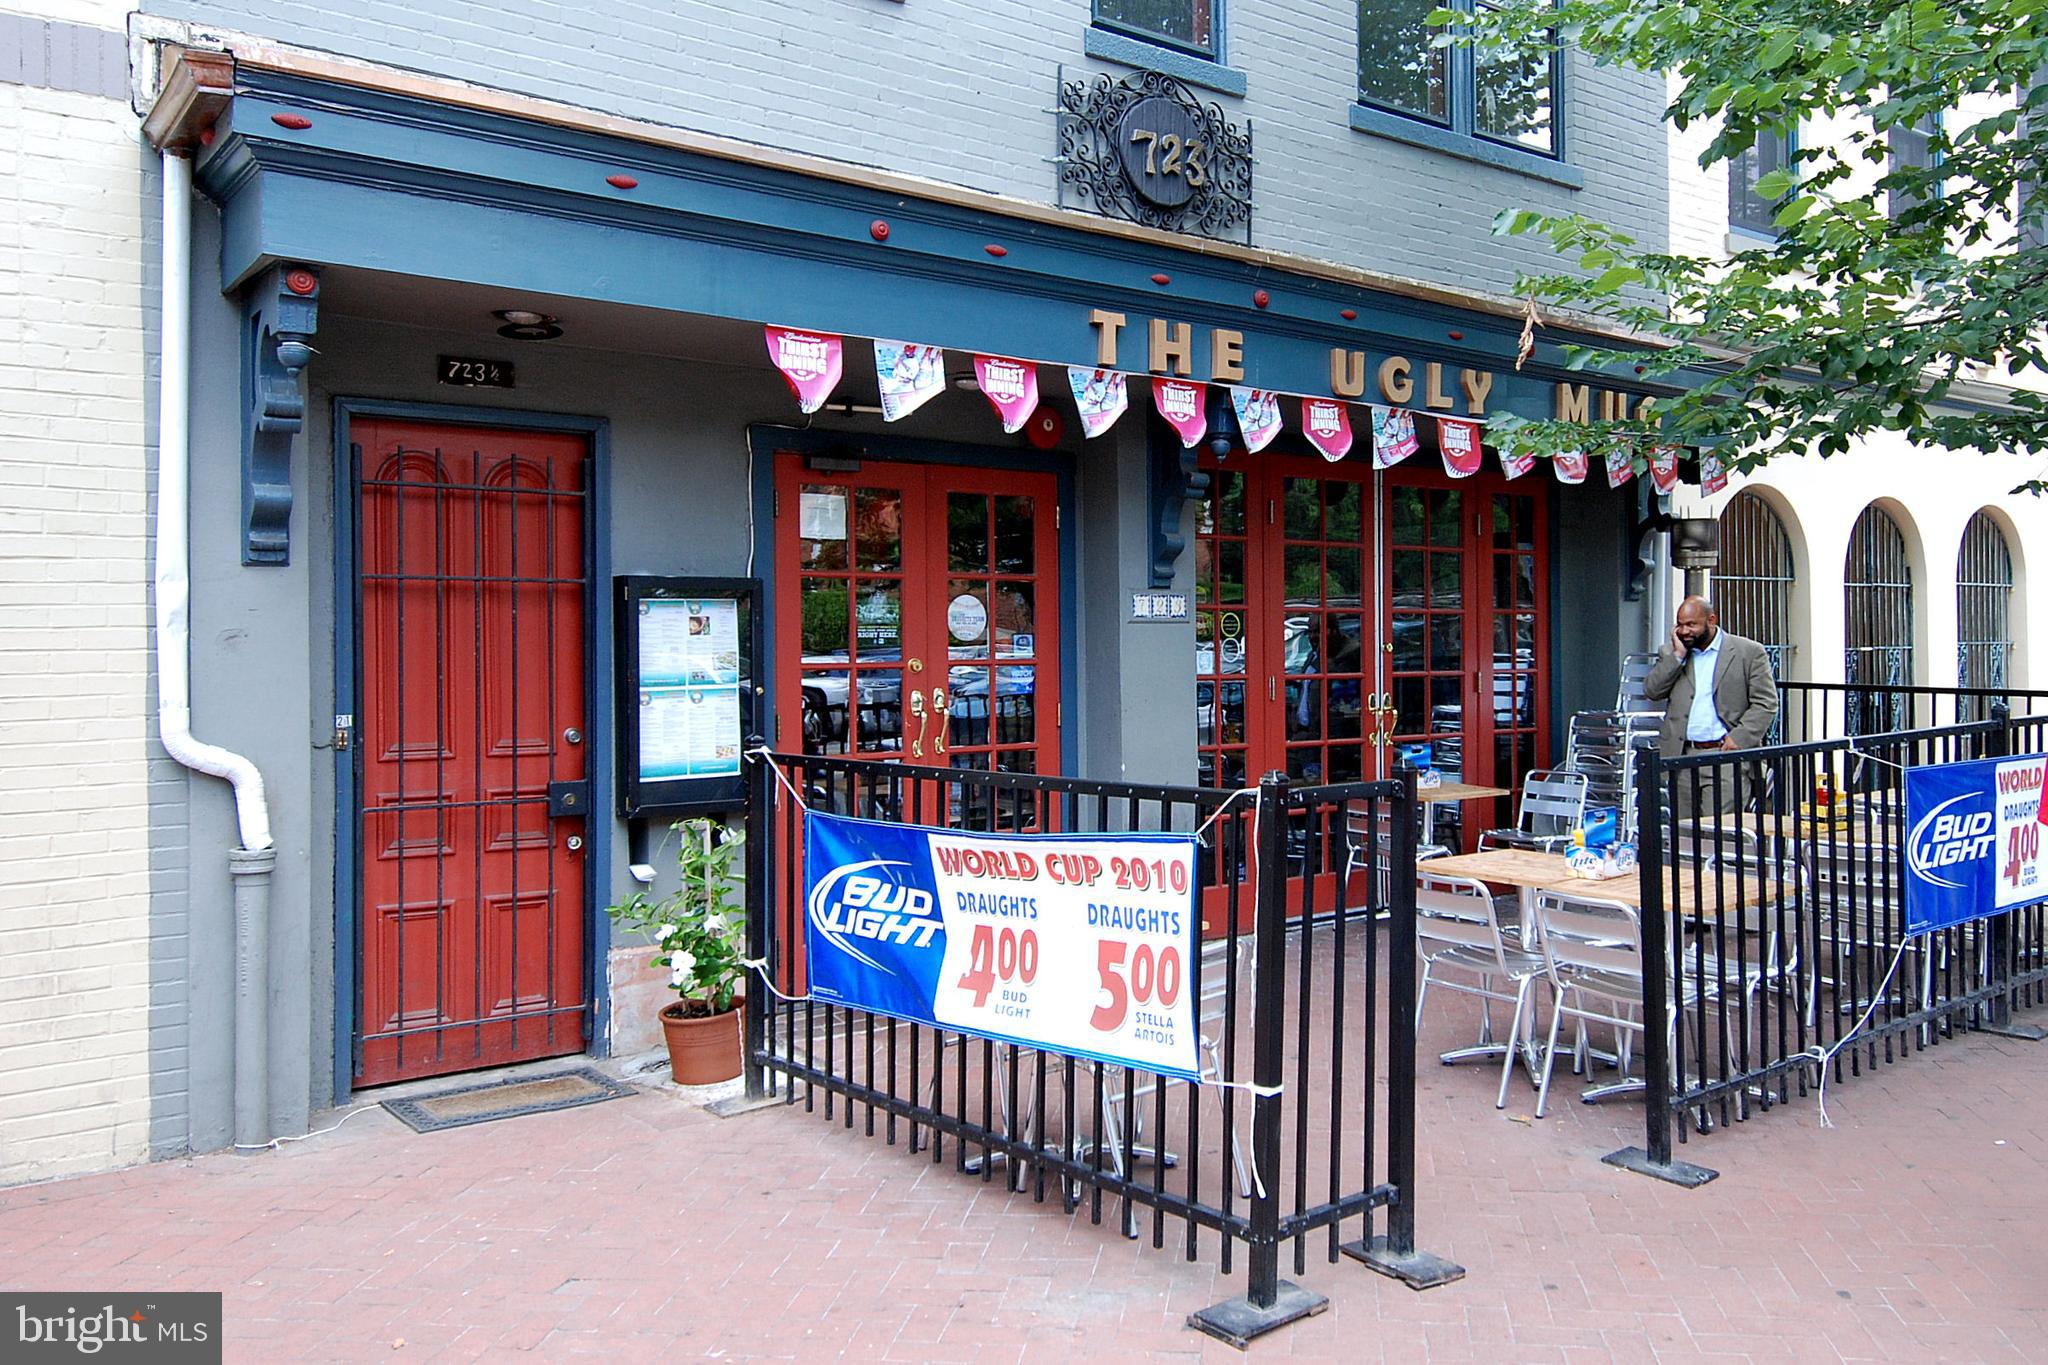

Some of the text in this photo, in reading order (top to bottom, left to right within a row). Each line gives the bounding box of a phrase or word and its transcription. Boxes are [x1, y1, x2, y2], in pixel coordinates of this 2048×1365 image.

[1130, 129, 1205, 186] 723
[777, 336, 828, 359] THIRST
[448, 361, 485, 382] 723
[984, 363, 1025, 383] THIRST
[1089, 308, 1245, 381] THE
[1331, 347, 1493, 415] UGLY
[1161, 385, 1197, 404] THIRST
[1309, 405, 1339, 420] THIRST
[1136, 597, 1183, 615] 723
[1998, 766, 2042, 795] WORLD
[2004, 800, 2039, 821] DRAUGHTS
[1932, 811, 1993, 844] BUD
[1918, 834, 1996, 871] LIGHT
[936, 846, 1188, 895] WORLD CUP 2010
[841, 875, 934, 916] BUD
[956, 891, 1039, 920] DRAUGHTS
[824, 902, 946, 949] LIGHT
[1087, 903, 1181, 936] DRAUGHTS
[1002, 989, 1028, 1003] BUD
[1089, 939, 1181, 1033] 500
[994, 1003, 1031, 1019] LIGHT
[1135, 1011, 1174, 1029] STELLA
[1134, 1027, 1175, 1046] ARTOIS
